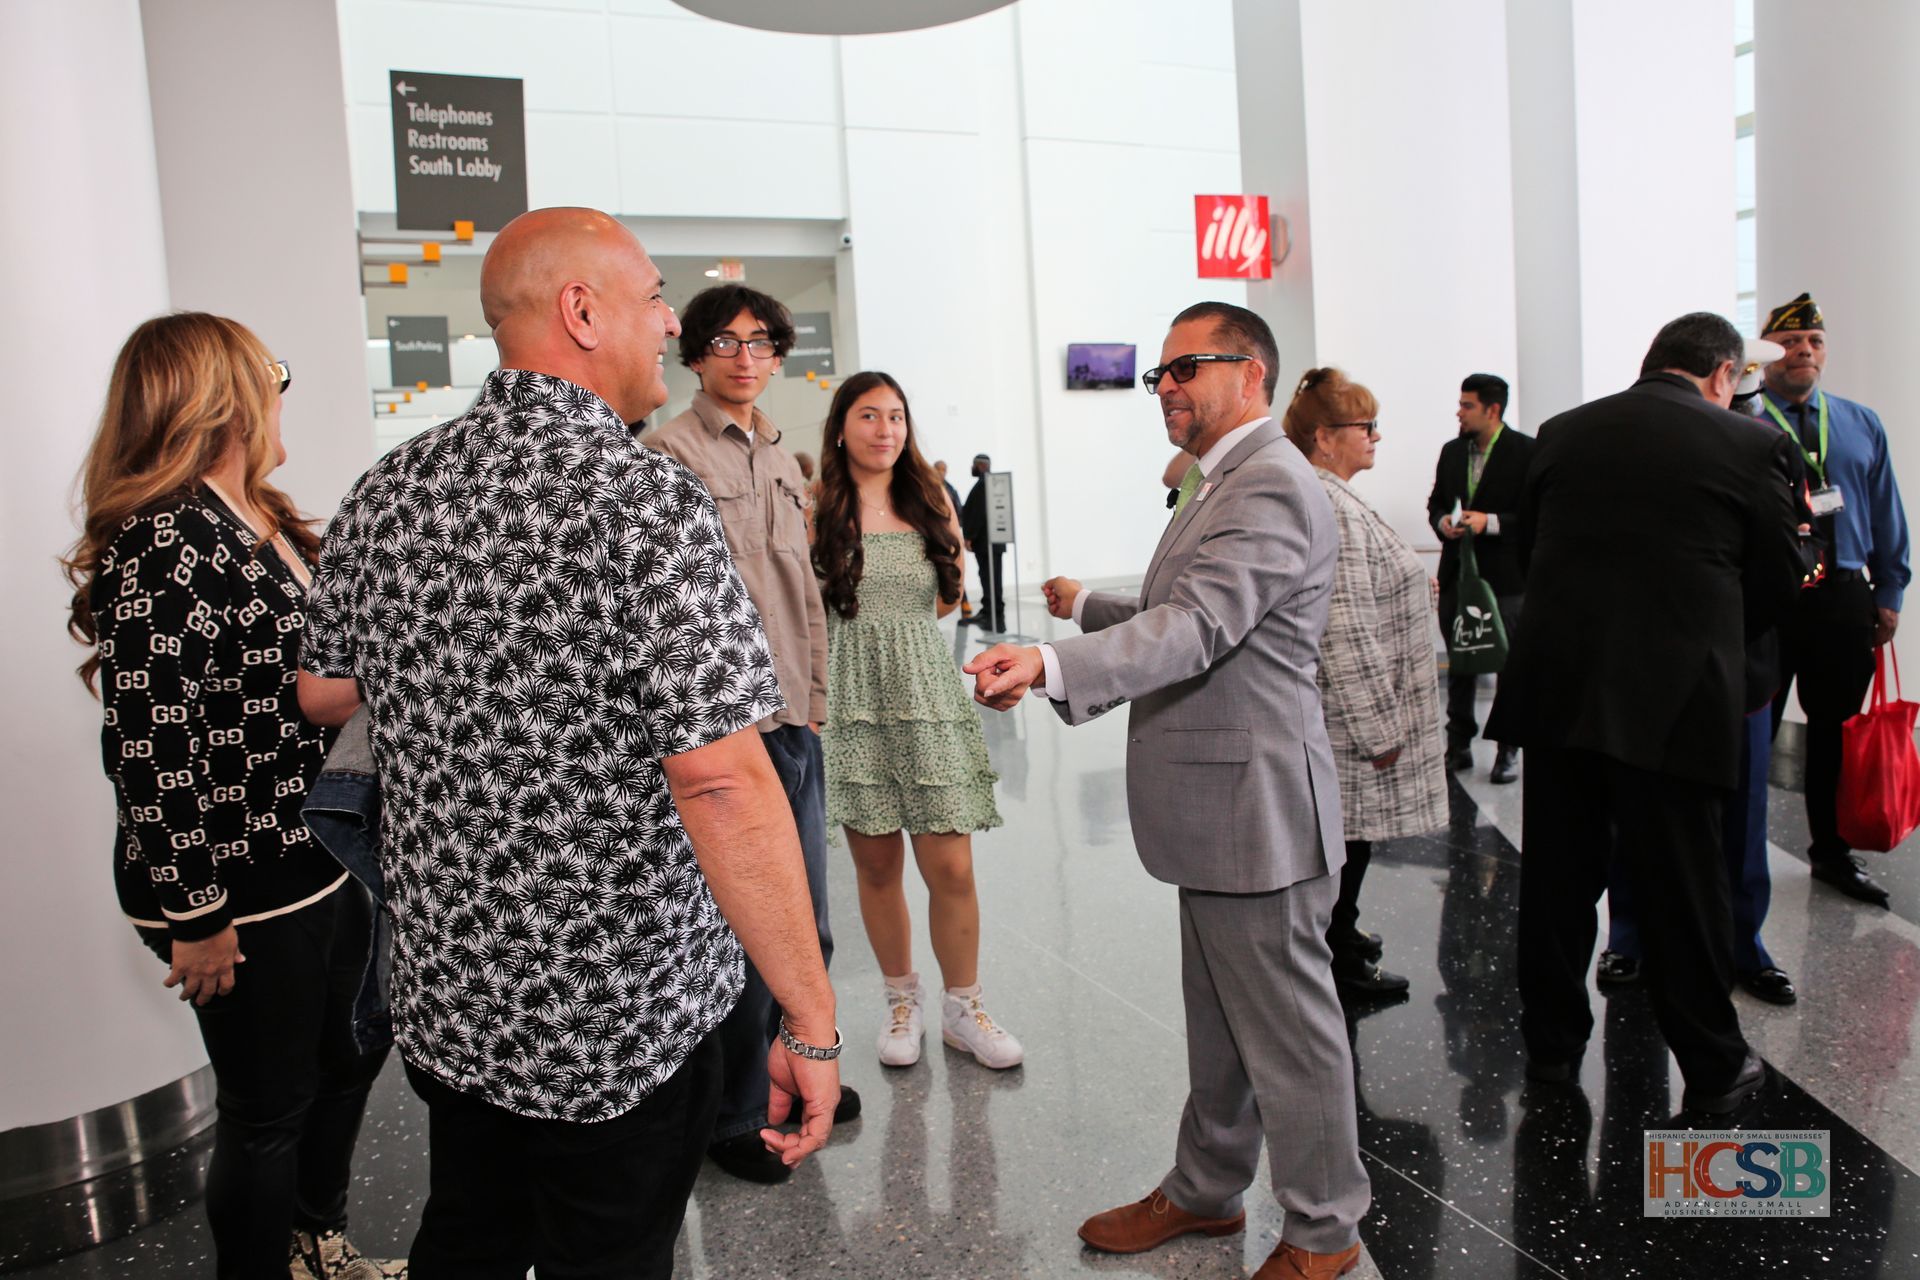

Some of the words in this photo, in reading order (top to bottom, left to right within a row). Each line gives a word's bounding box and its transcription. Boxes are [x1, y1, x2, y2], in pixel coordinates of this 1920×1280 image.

[406, 101, 493, 129] Telephones
[407, 128, 488, 152] Restrooms
[409, 154, 453, 175] South
[457, 156, 502, 182] Lobby
[1201, 204, 1267, 272] illy
